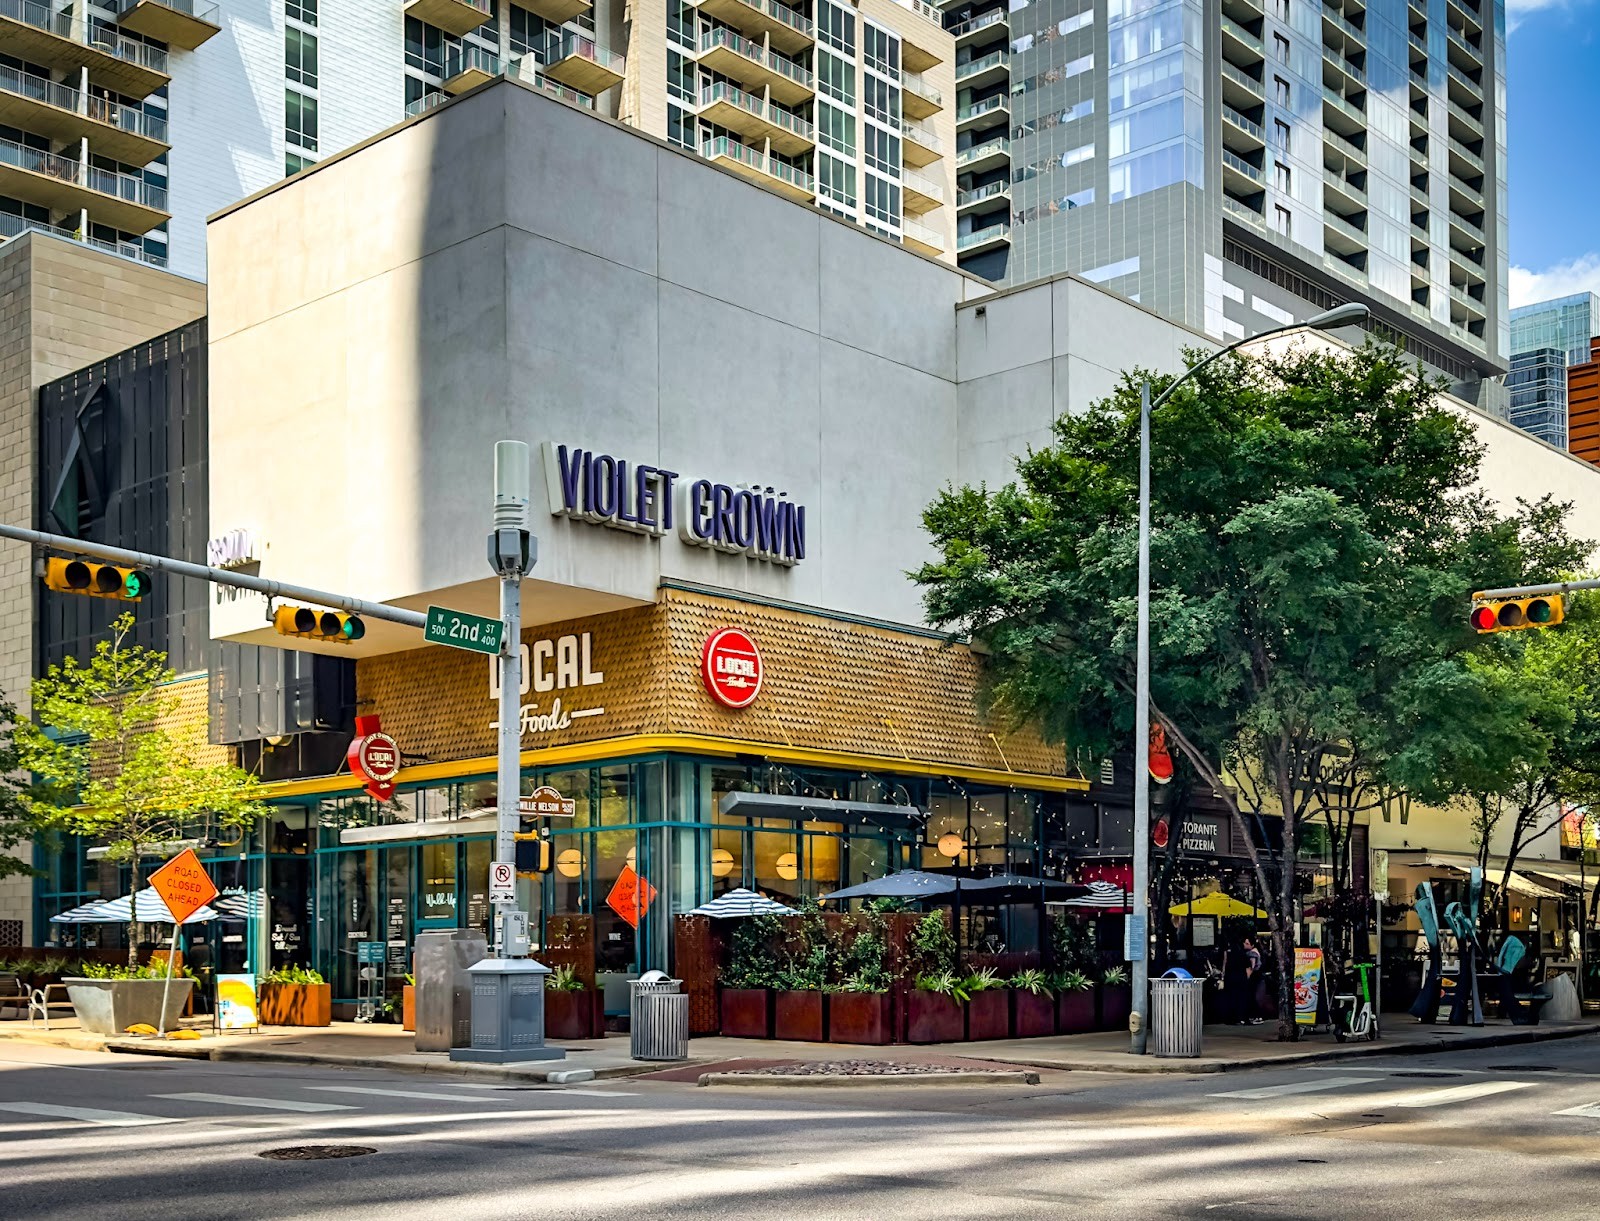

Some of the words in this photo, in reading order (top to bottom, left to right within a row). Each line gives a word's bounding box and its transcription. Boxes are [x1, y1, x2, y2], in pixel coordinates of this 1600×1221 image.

[557, 445, 679, 530] VIOLET
[692, 479, 806, 560] CROWN
[431, 624, 447, 636] 500
[437, 613, 445, 624] W
[449, 617, 480, 642] 2nd
[485, 623, 496, 634] ST
[481, 635, 496, 647] 400
[716, 655, 758, 678] LOCAL
[519, 697, 572, 737] Foods
[367, 751, 394, 762] LOCAL
[538, 802, 560, 812] NELSON
[1181, 821, 1218, 836] TORANTE
[1182, 838, 1216, 852] PIZZERIA
[174, 866, 199, 879] ROAD
[167, 878, 202, 893] CLOSED
[168, 892, 199, 906] AHEAD
[608, 933, 622, 941] WINE
[1295, 951, 1317, 959] EEKEND
